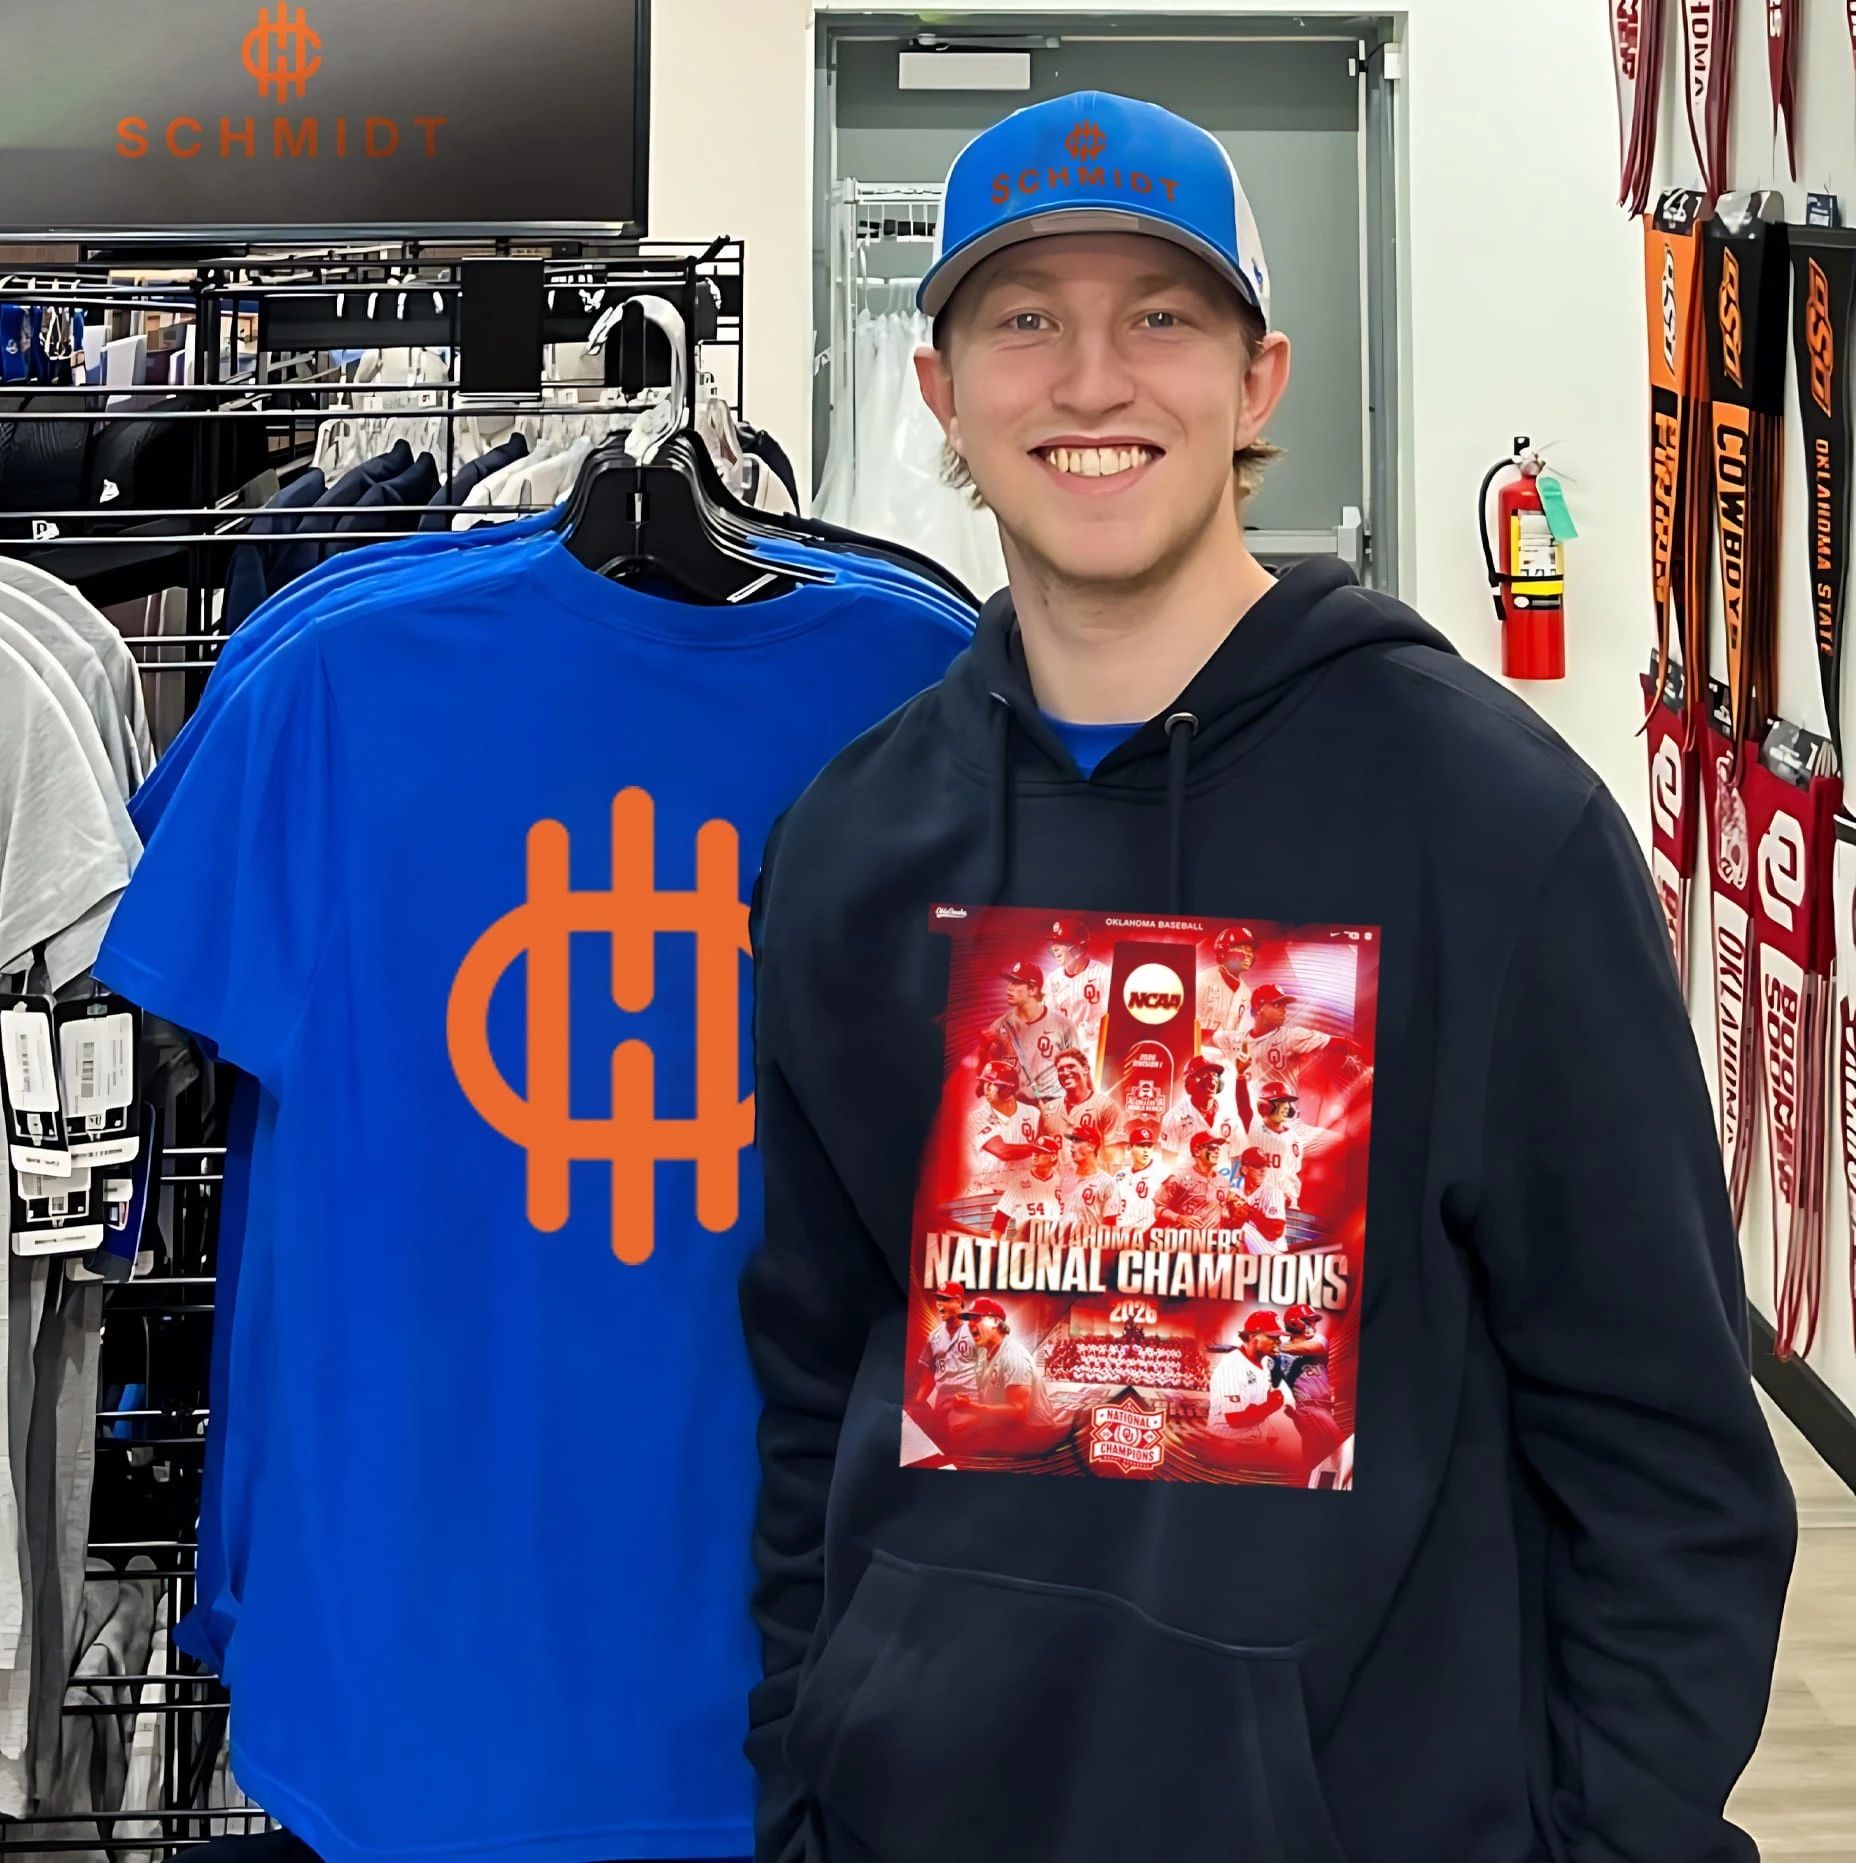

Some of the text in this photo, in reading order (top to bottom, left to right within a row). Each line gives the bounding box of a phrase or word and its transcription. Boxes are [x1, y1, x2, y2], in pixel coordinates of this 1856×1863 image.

[115, 115, 447, 159] SCHMIDT
[992, 165, 1180, 204] SCHMIDT
[1815, 438, 1832, 570] OKLAHOMA
[1105, 917, 1204, 931] OKLAHOMA BASEBALL
[1128, 991, 1182, 1010] NCAA
[1037, 1035, 1054, 1059] OU
[1135, 1180, 1149, 1200] OU
[1026, 1202, 1045, 1217] 54
[1028, 1219, 1245, 1254] OKLAHOMA SOONERS
[924, 1232, 1349, 1311] NATIONAL CHAMPIONS
[1109, 1300, 1158, 1324] 2026
[1107, 1409, 1151, 1428] NATIONAL
[1100, 1443, 1155, 1462] CHAMPIONS
